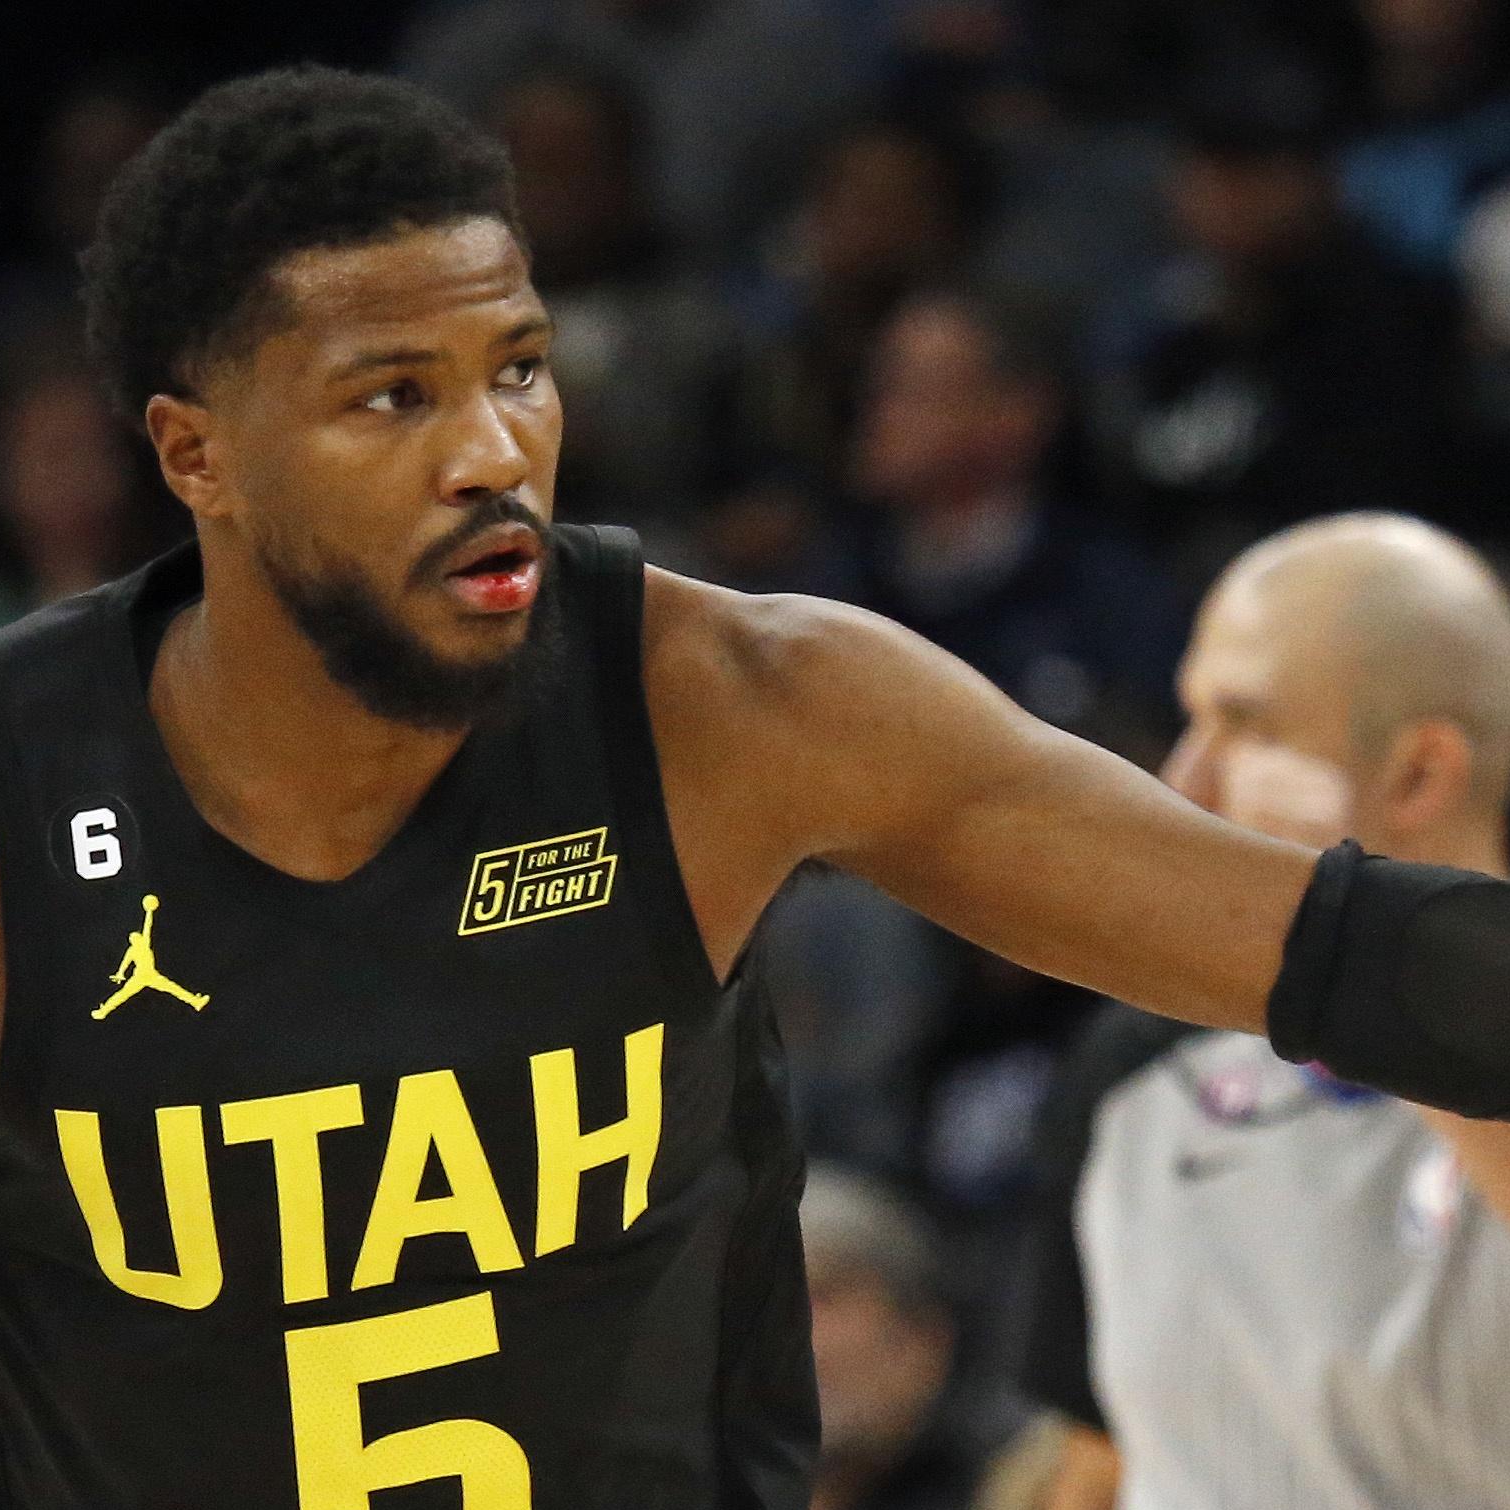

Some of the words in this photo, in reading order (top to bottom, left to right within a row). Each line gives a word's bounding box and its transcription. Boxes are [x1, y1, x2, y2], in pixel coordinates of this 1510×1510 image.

[70, 807, 123, 880] 6
[526, 849, 559, 870] FOR
[563, 841, 594, 862] THE
[473, 859, 510, 922] 5
[517, 869, 604, 913] FIGHT
[54, 1023, 665, 1311] UTAH
